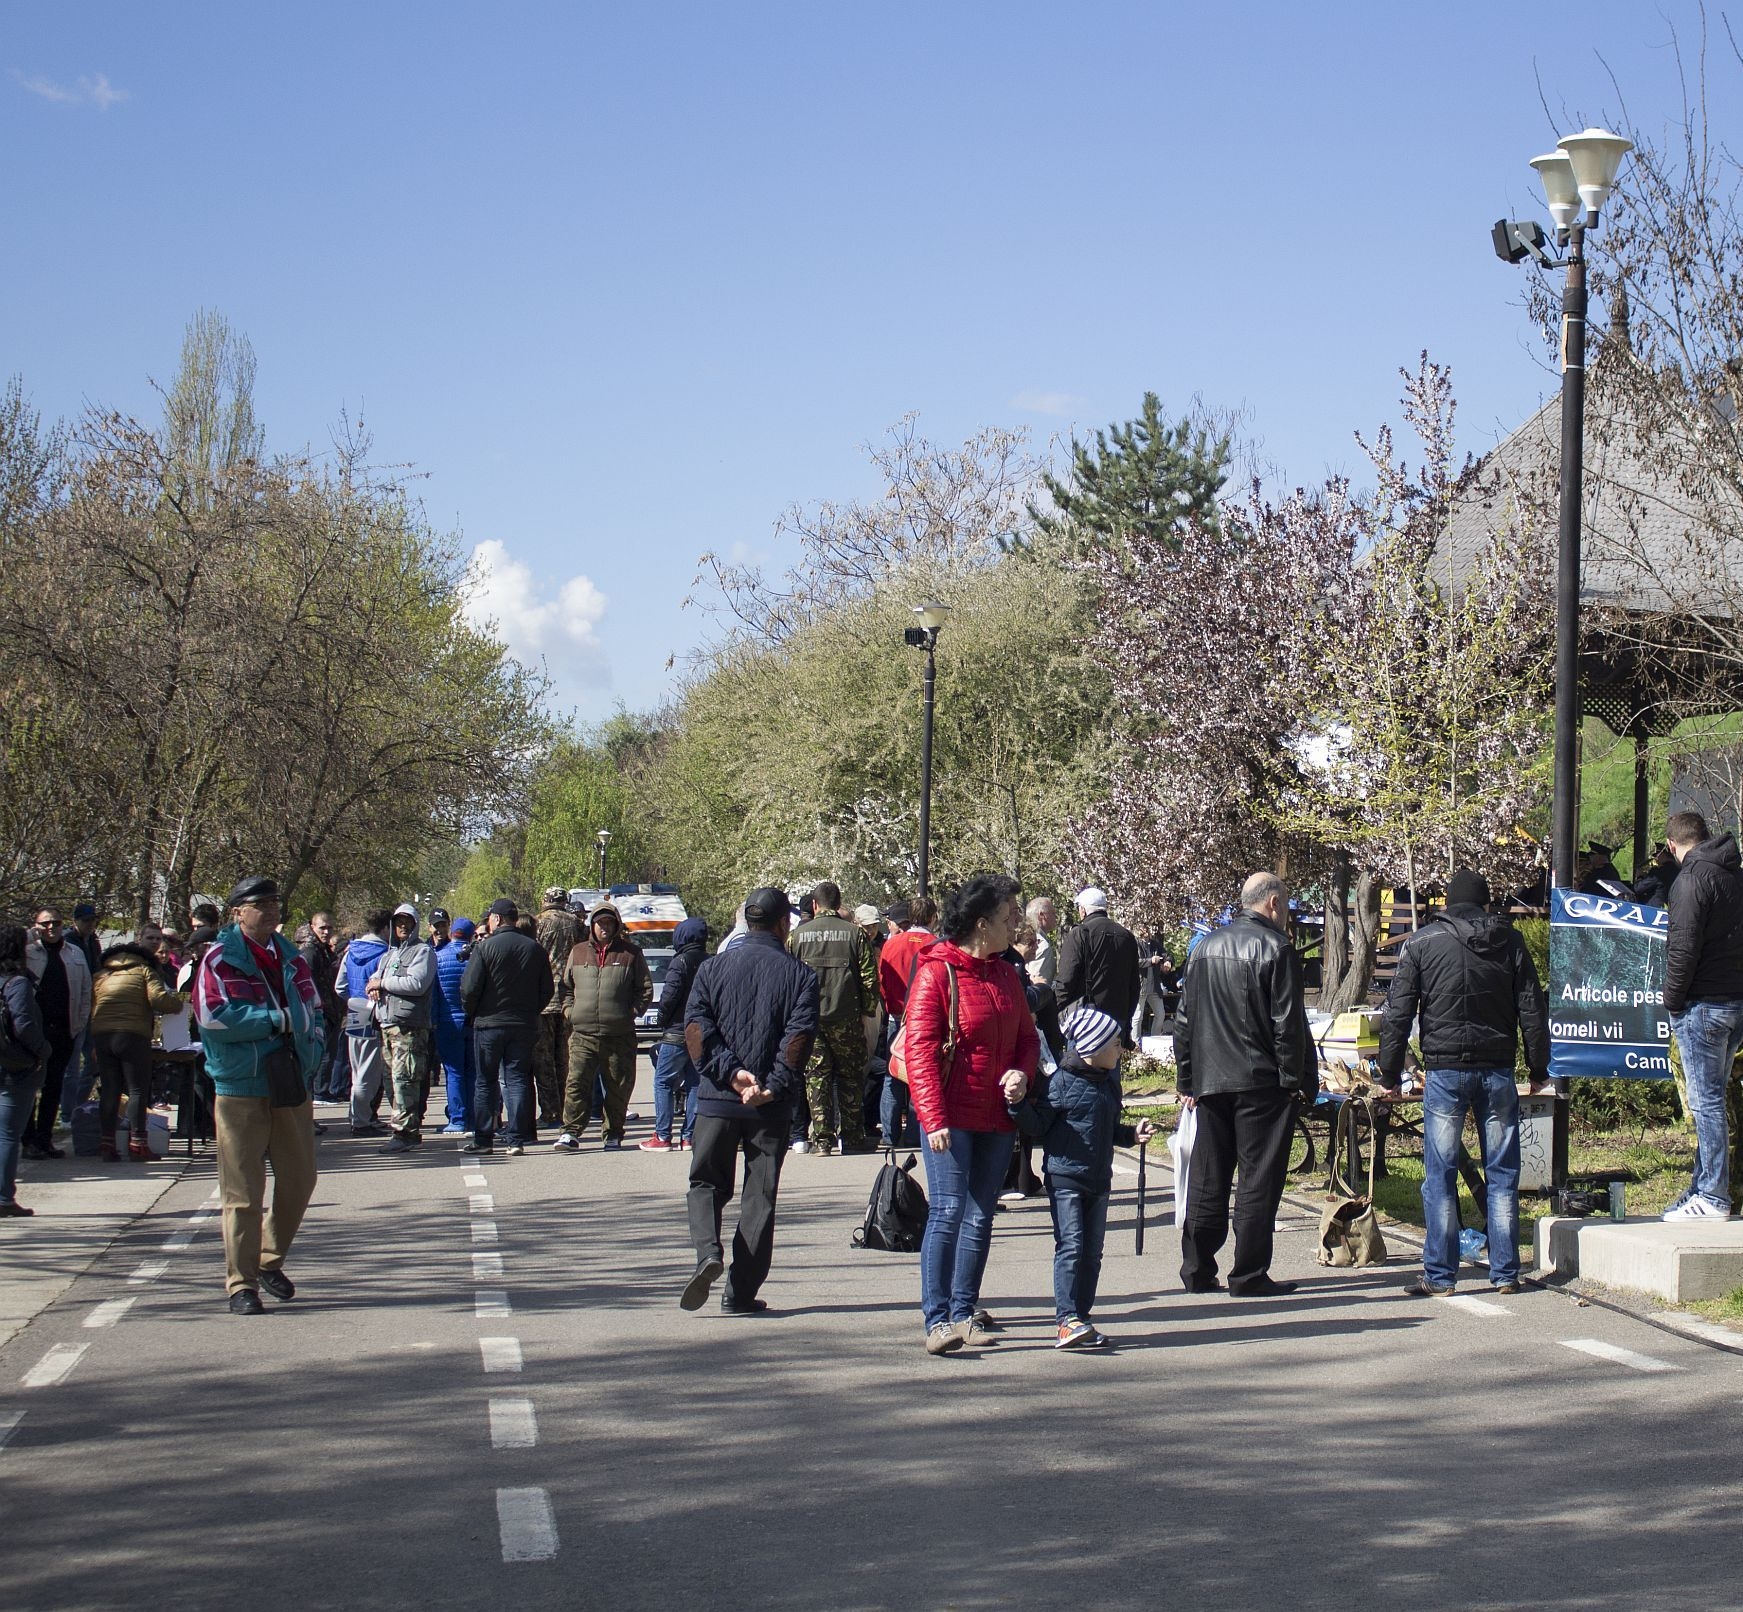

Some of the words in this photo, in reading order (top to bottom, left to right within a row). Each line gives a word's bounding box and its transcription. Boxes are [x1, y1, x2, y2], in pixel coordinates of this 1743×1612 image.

[1561, 983, 1628, 1003] Articole
[1549, 1018, 1598, 1038] omeli
[1602, 1022, 1623, 1039] vii
